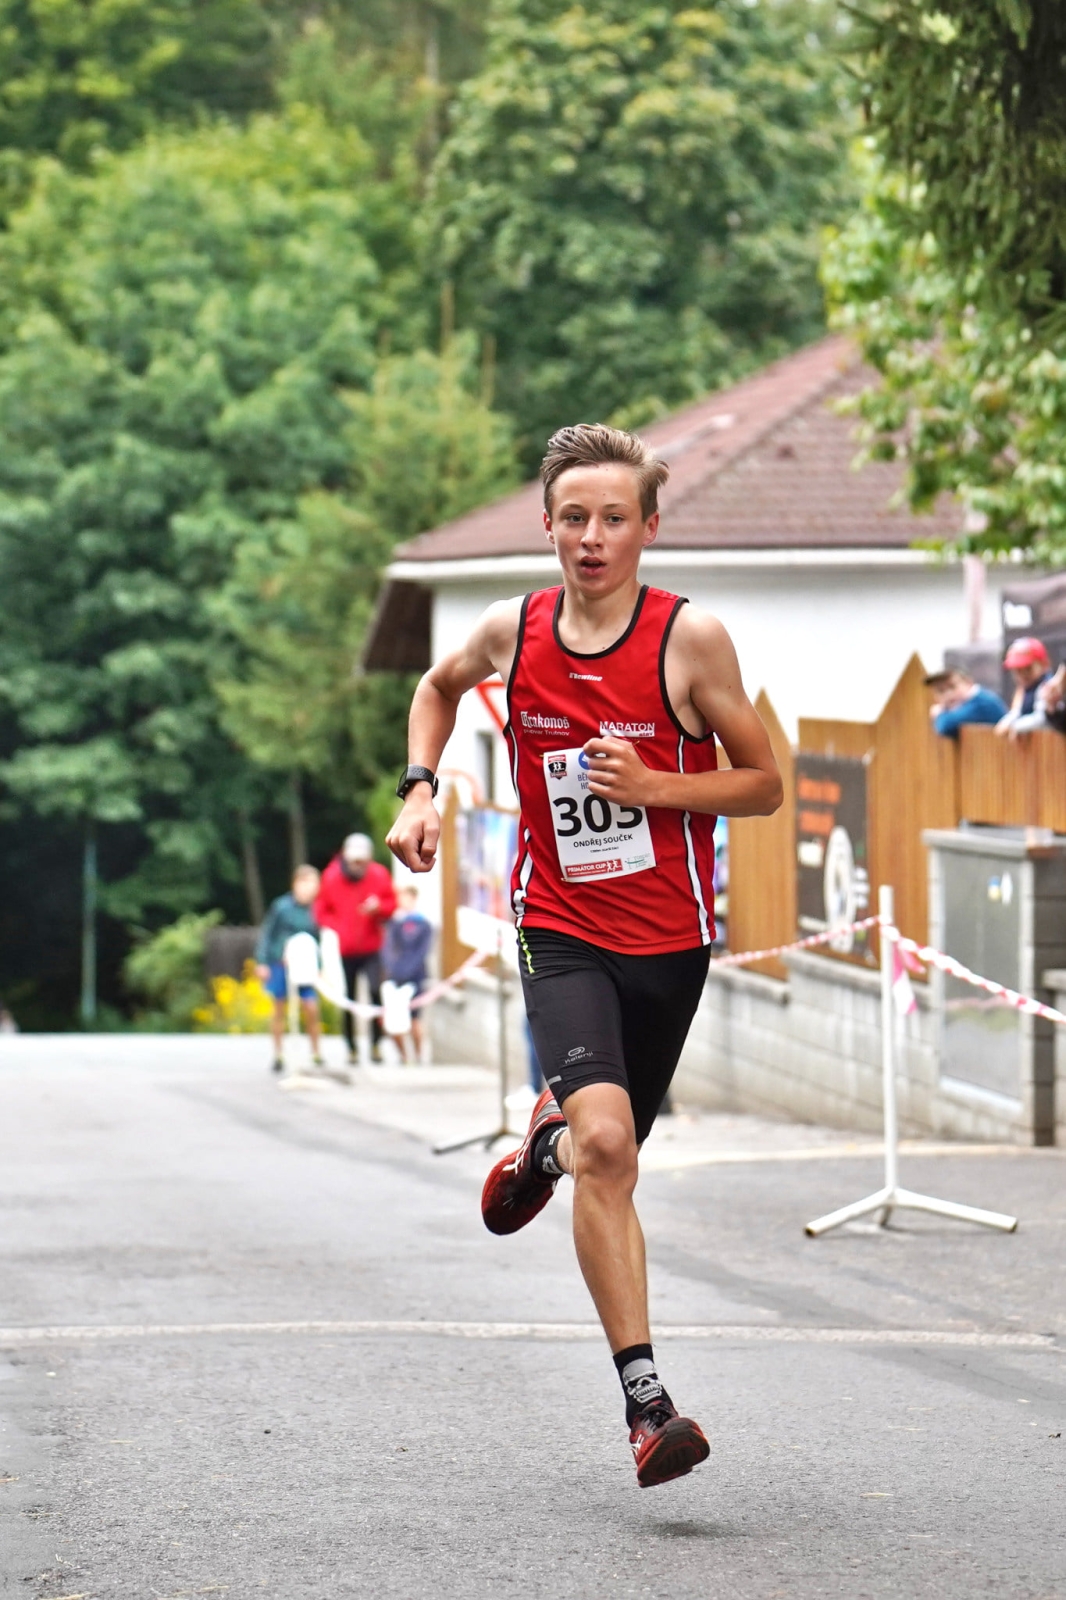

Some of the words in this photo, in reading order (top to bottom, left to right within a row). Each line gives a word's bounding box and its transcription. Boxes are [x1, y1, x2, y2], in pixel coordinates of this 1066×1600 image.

[520, 711, 570, 729] Krakonoš
[599, 721, 655, 732] MARATON
[573, 838, 602, 848] ONDŘEJ
[603, 833, 633, 844] SOUČEK
[567, 863, 595, 873] PRIMÁTOR
